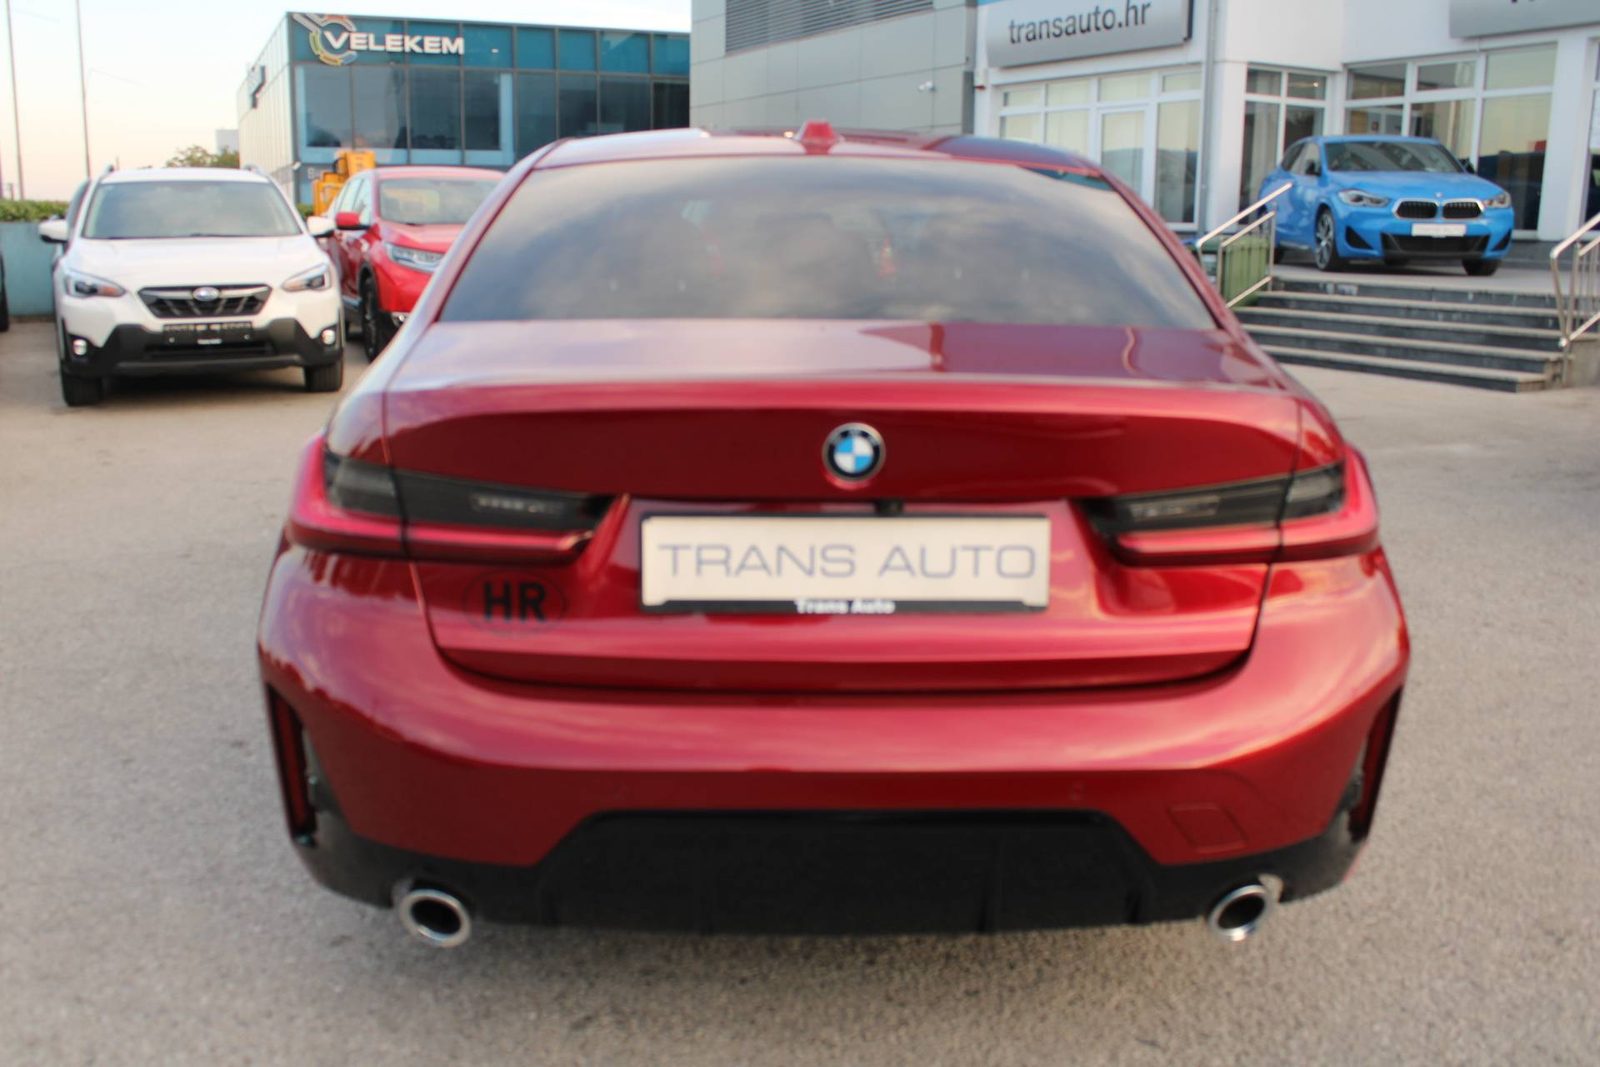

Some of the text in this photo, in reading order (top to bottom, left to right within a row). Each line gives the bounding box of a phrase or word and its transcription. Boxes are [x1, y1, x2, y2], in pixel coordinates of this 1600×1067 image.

[1008, 0, 1152, 44] transauto.hr
[324, 31, 465, 55] VELEKEM
[658, 544, 1037, 578] TRANS AUTO
[484, 581, 547, 624] HR
[794, 598, 896, 614] Trans Auto
